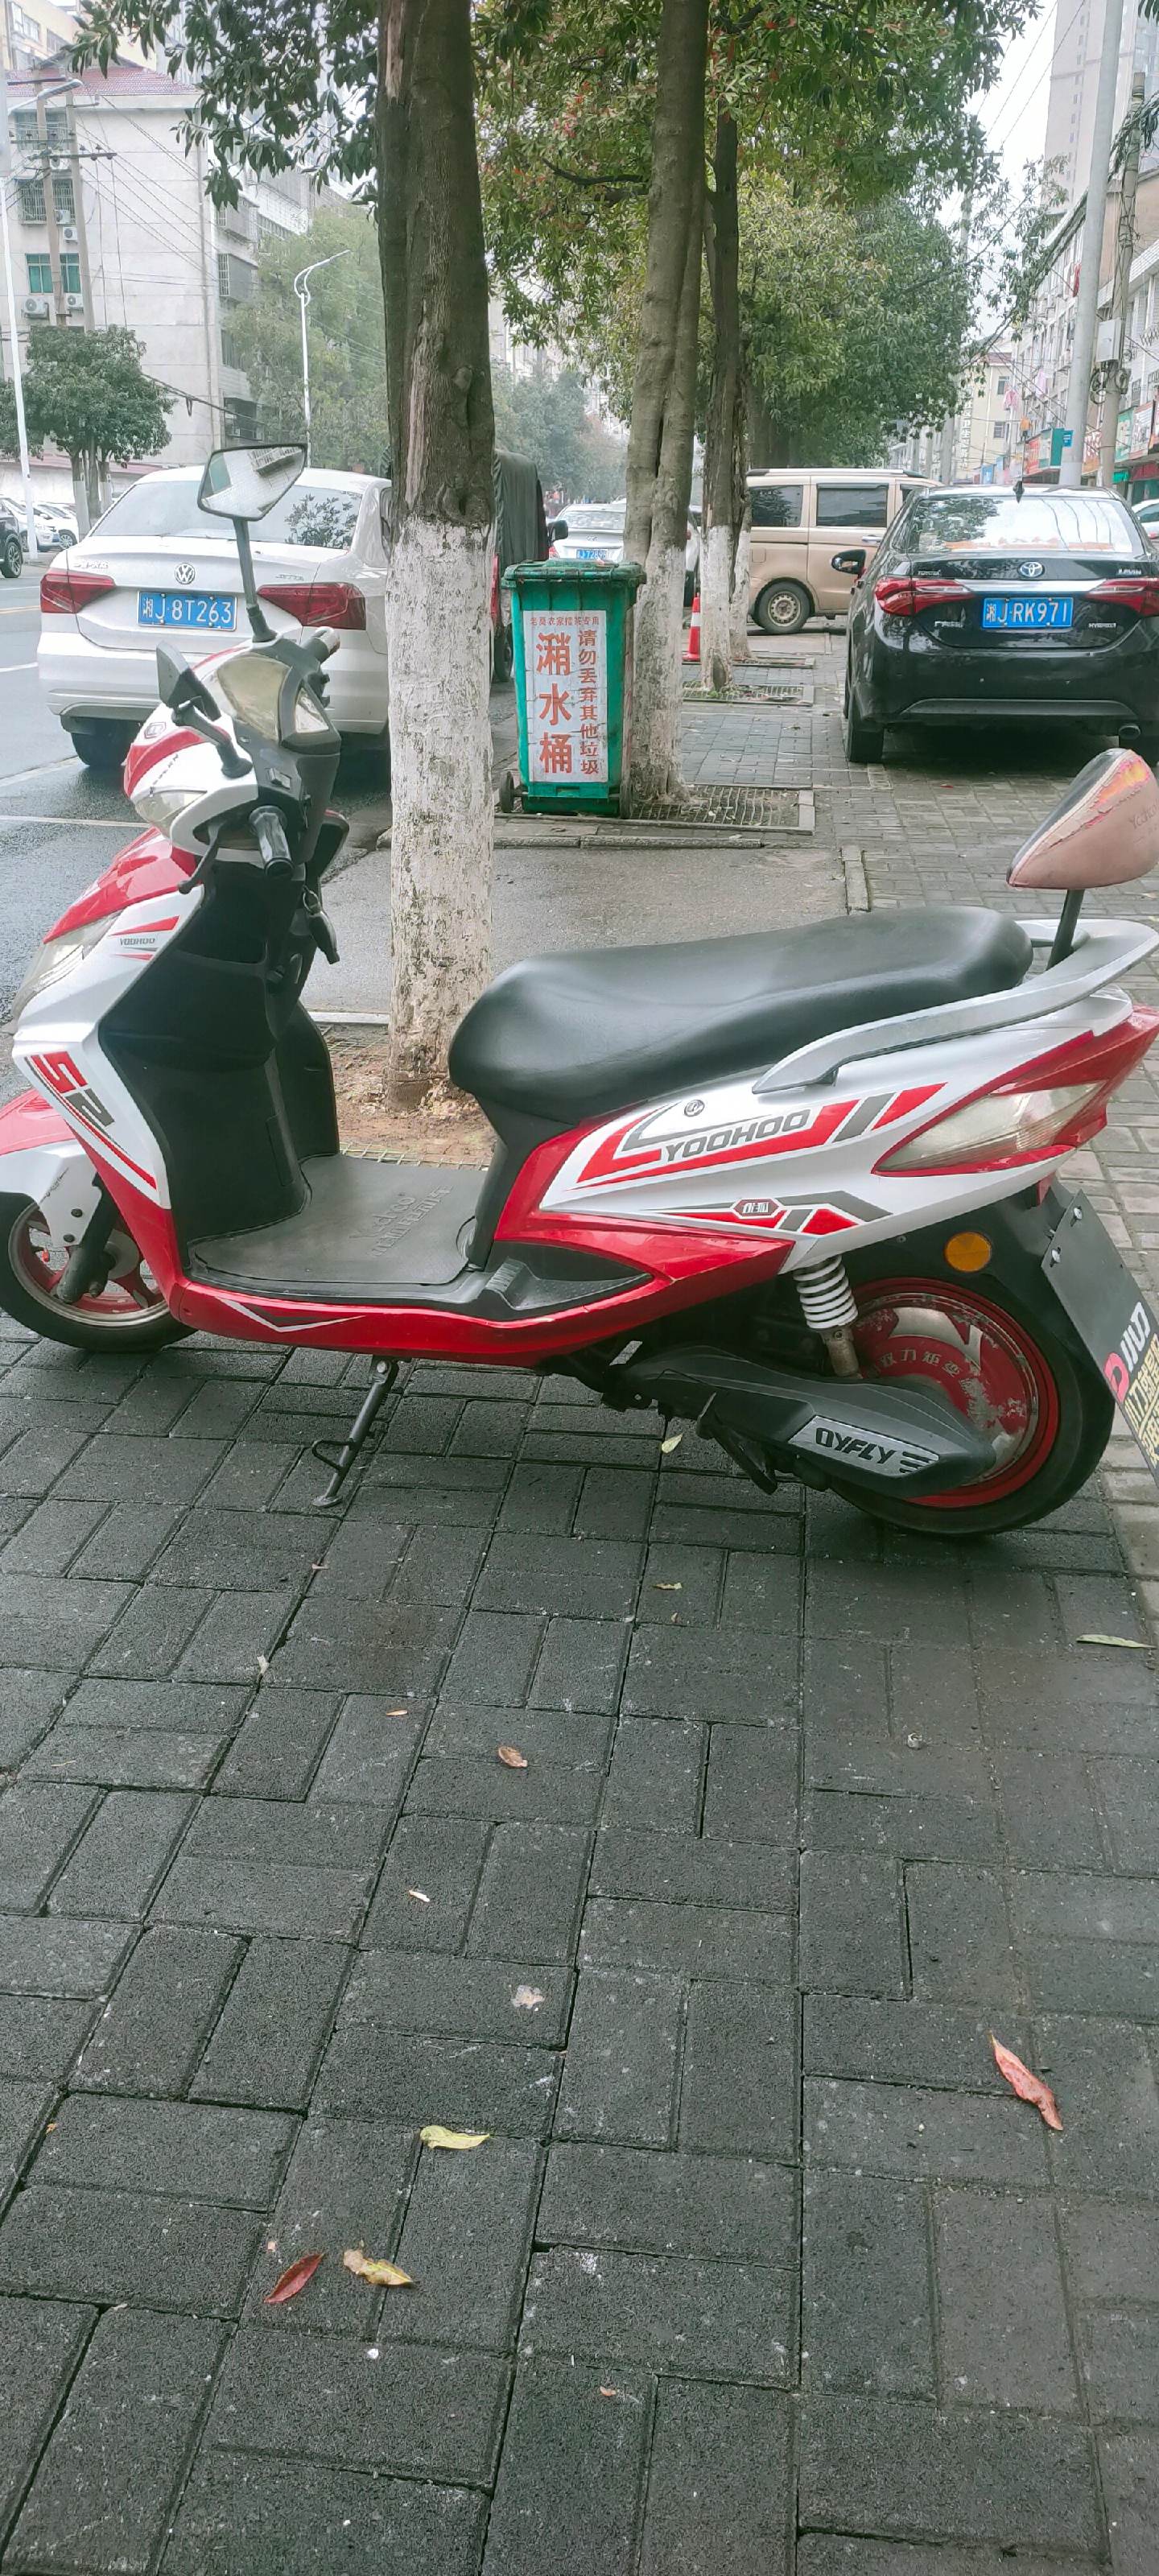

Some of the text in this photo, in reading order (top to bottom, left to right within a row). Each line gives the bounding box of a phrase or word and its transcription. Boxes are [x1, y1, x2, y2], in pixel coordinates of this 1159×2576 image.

[578, 630, 599, 774] 请勿丢弃其他垃圾
[665, 1109, 811, 1162] YOOHOO
